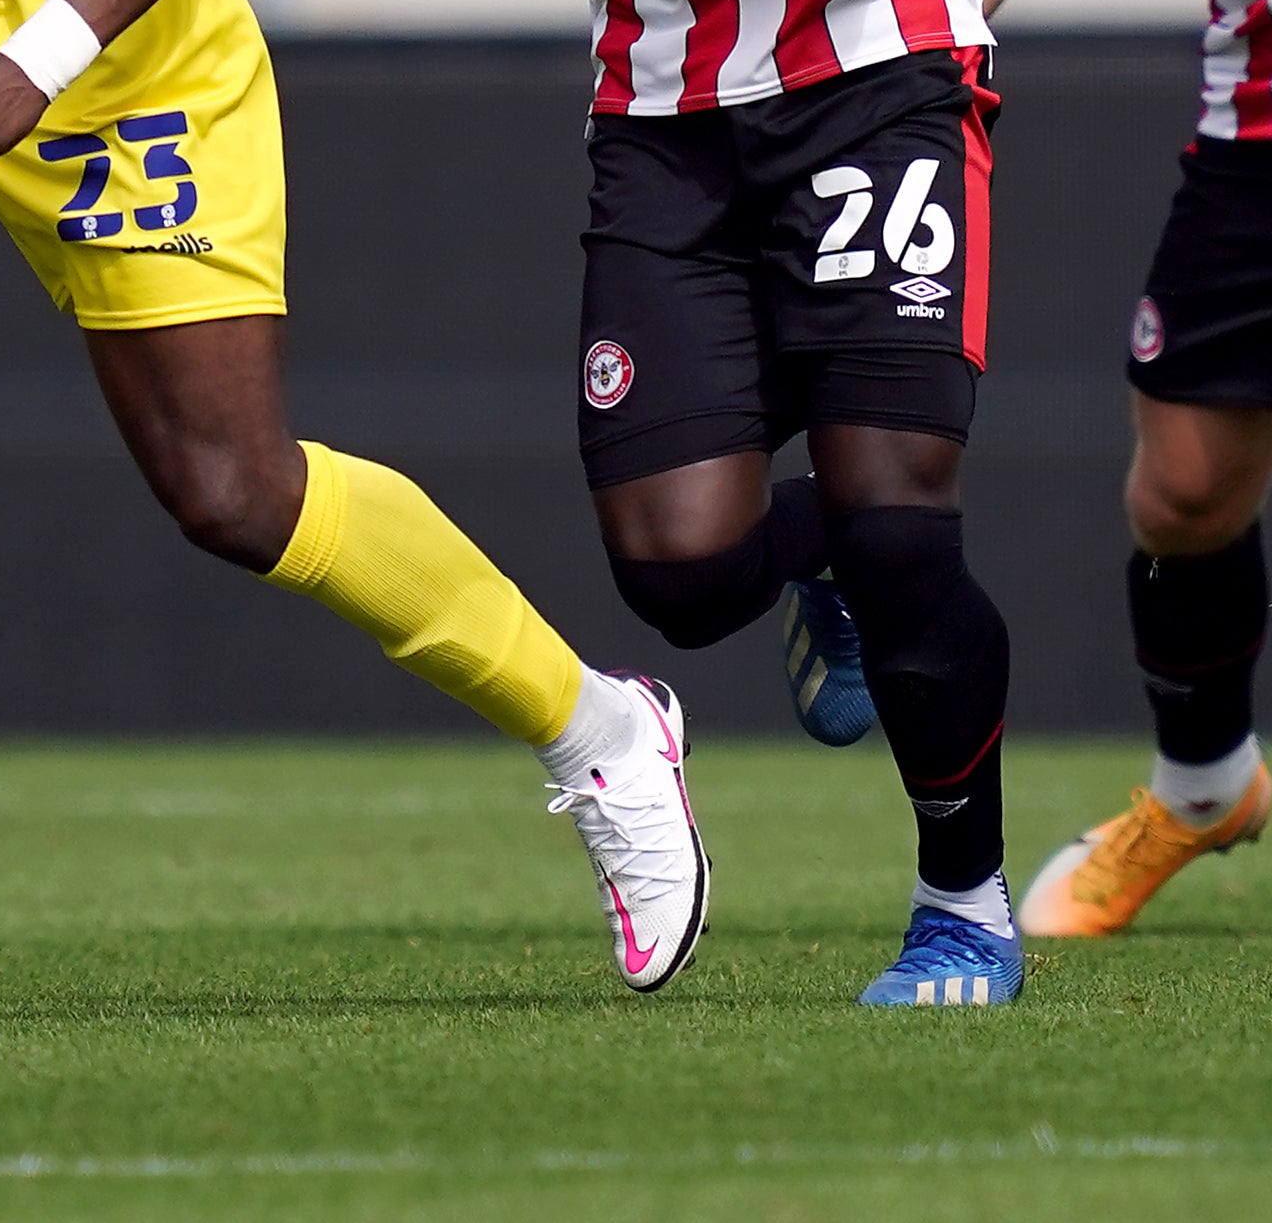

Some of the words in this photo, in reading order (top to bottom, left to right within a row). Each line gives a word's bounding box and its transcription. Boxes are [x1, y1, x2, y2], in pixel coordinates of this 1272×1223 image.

[38, 111, 197, 242] 23
[811, 158, 955, 283] 26
[896, 303, 945, 320] umbro
